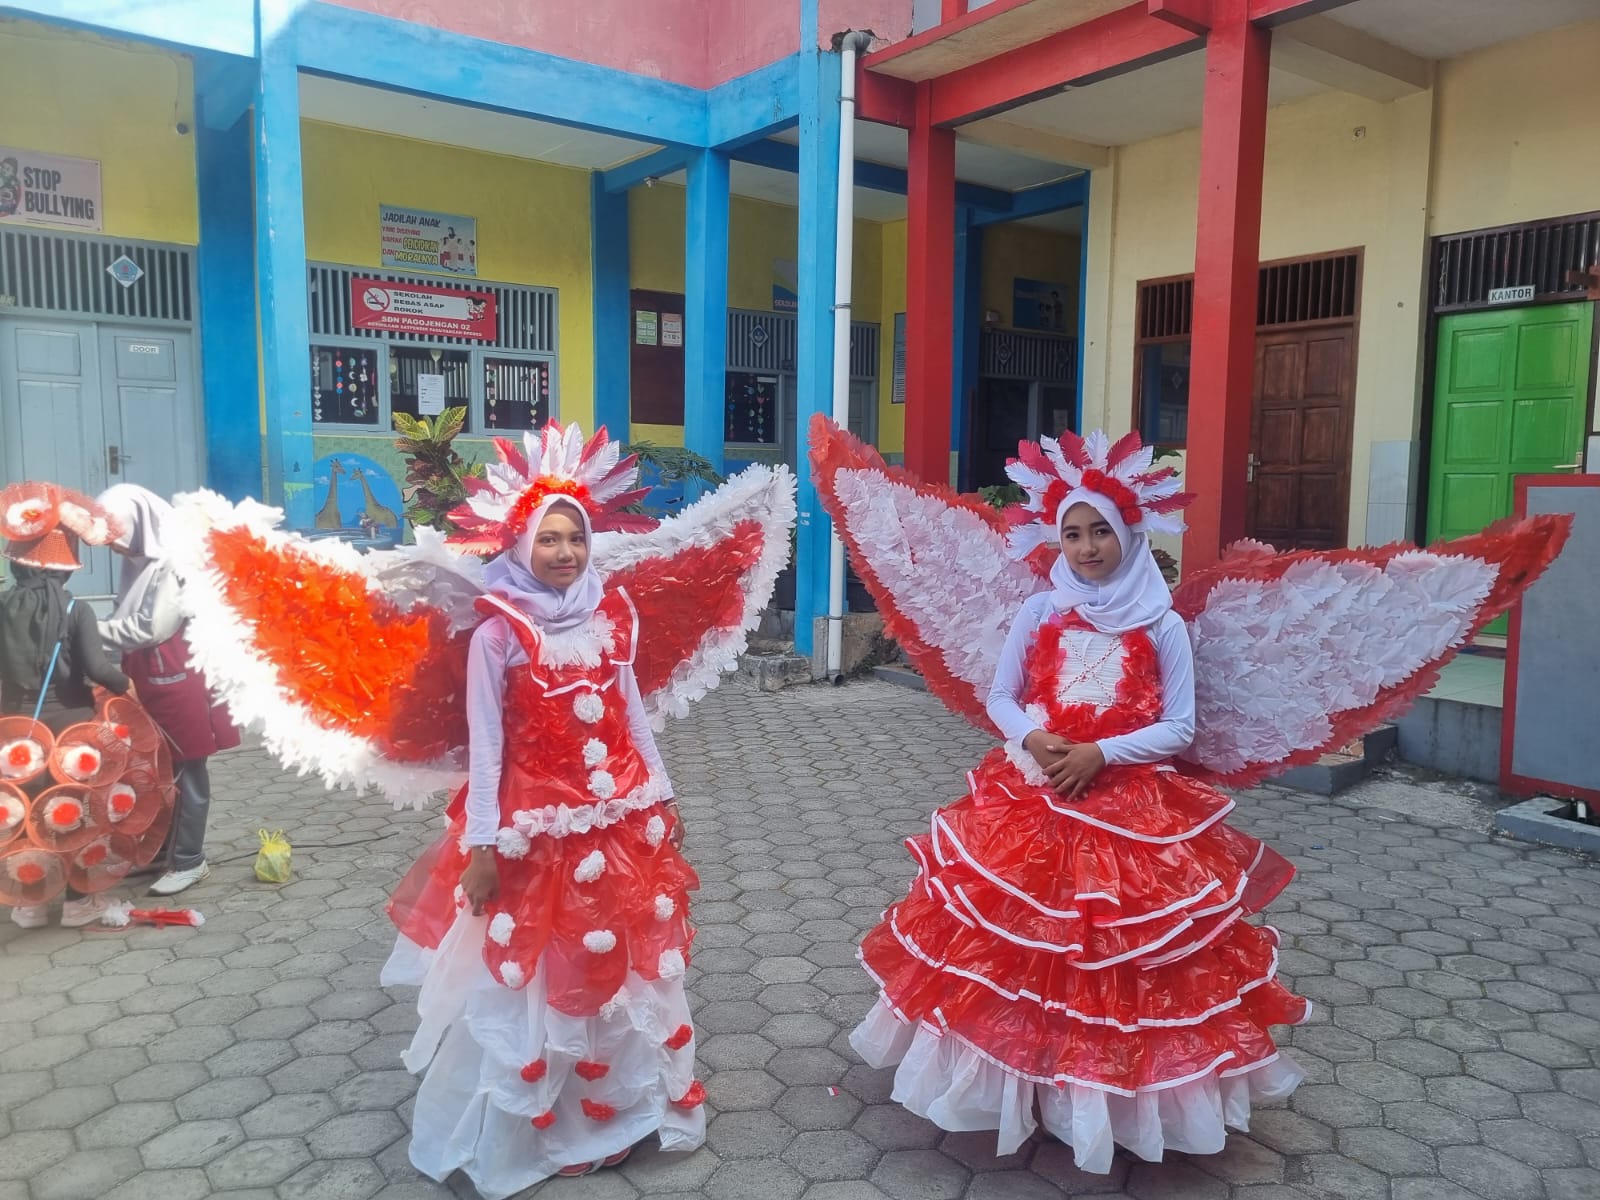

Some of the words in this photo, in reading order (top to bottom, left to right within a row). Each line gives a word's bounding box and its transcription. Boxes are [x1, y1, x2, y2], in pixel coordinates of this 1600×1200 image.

[23, 166, 61, 191] STOP
[24, 190, 95, 220] BULLYING
[382, 212, 418, 225] JADILAH
[419, 216, 441, 228] ANAK
[402, 236, 439, 253] PENDIDIKAN
[395, 250, 439, 266] MORALNYA
[393, 291, 433, 300] SEKOLAH
[1491, 288, 1532, 301] KANTOR
[393, 299, 422, 307] BEBAS
[393, 306, 424, 314] ROKOK
[382, 315, 400, 324] SDN
[402, 317, 459, 330] PAGOJENGAN
[460, 323, 471, 331] 02
